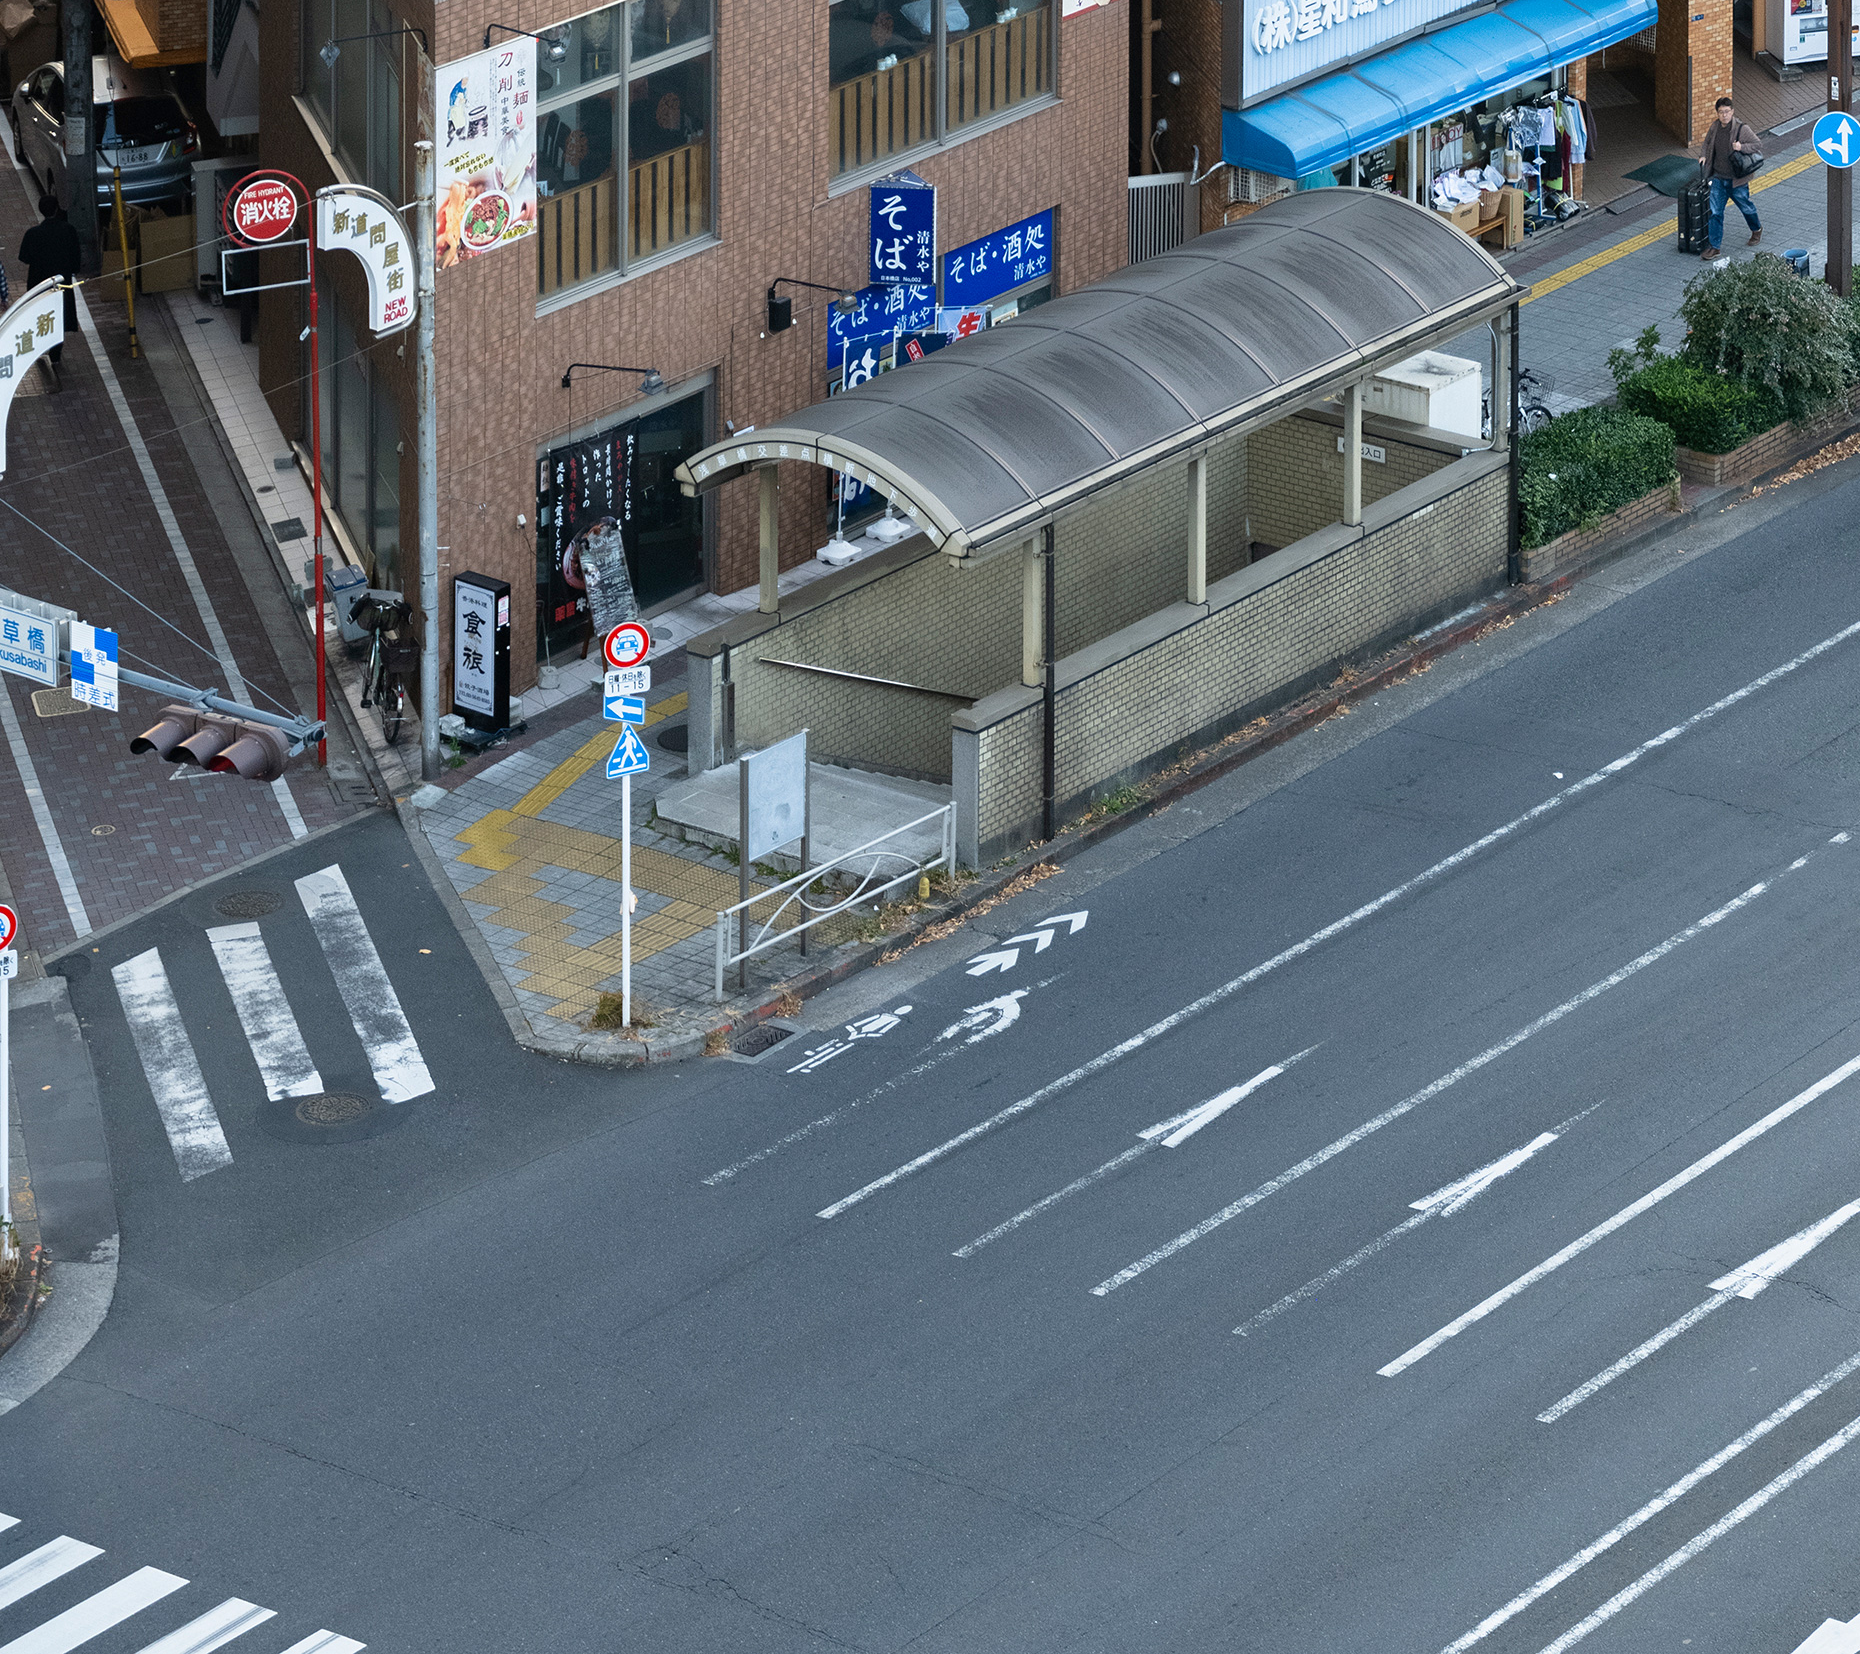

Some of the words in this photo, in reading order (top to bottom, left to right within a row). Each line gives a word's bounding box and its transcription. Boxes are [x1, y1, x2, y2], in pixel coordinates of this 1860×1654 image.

[243, 191, 257, 199] FIRE
[258, 186, 284, 196] HYDRANT
[241, 195, 291, 226] 消火栓
[874, 195, 914, 271] そば
[333, 208, 404, 293] 新道問屋街
[916, 230, 930, 273] 清水や
[950, 223, 1045, 284] そば・酒処
[1013, 255, 1046, 282] 清水や
[384, 306, 408, 325] ROAD
[385, 295, 407, 312] NEW
[2, 618, 45, 654] 草橋
[74, 681, 116, 709] 時差式
